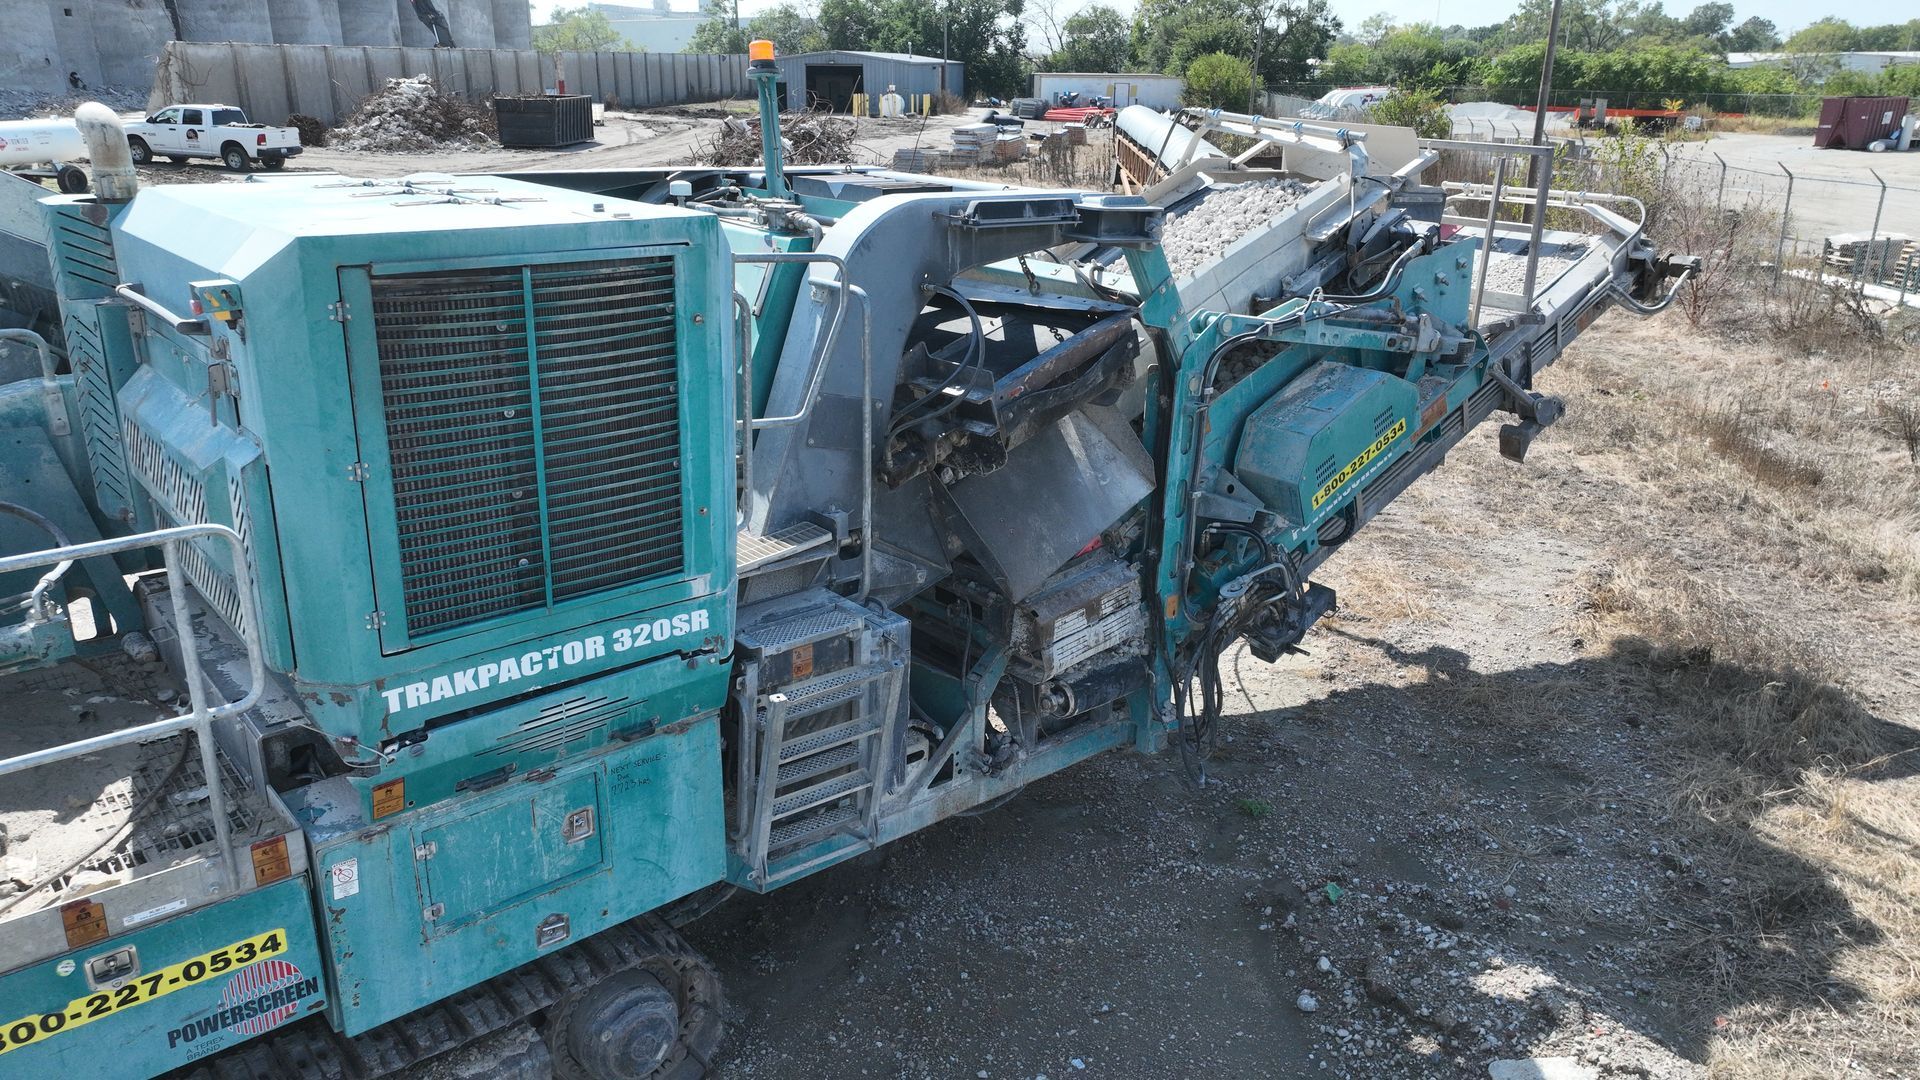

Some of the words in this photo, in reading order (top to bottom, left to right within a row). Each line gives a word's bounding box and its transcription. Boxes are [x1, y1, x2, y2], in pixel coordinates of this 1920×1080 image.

[1312, 420, 1405, 507] 1-800-227-0534
[381, 635, 605, 714] TRAKPACTOR
[612, 608, 710, 652] 320SR
[610, 763, 630, 775] NEXT
[0, 933, 282, 1051] 00-227-0534
[167, 976, 320, 1049] POWERSCREEN
[185, 1047, 194, 1056] A
[193, 1035, 225, 1052] TEREX
[186, 1043, 221, 1062] BRAND
